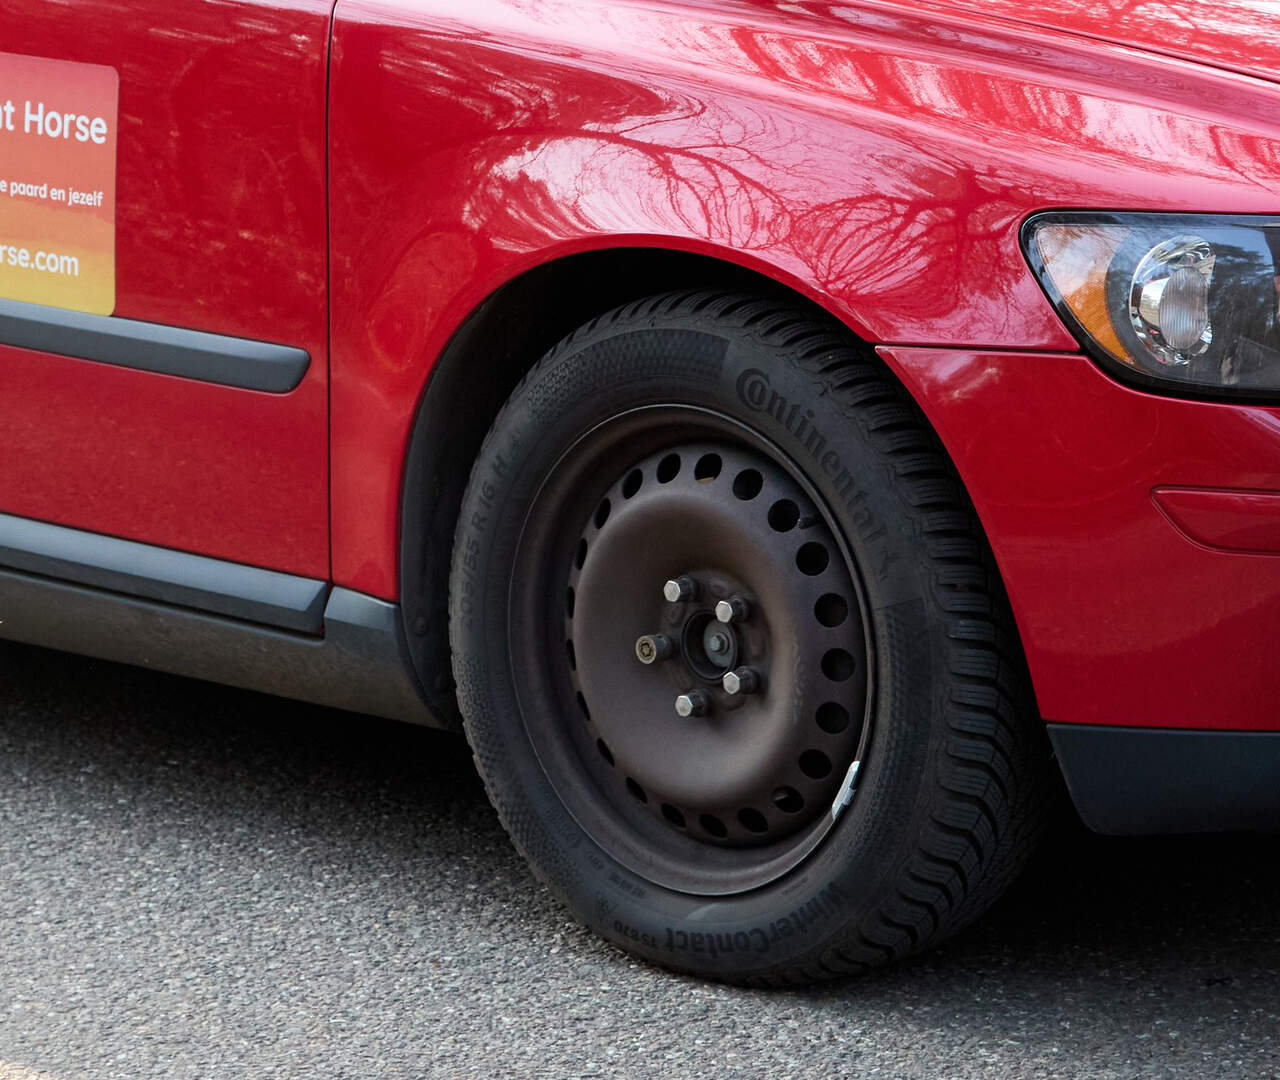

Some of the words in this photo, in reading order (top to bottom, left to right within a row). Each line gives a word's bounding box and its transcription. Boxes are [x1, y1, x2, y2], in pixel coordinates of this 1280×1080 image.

[23, 100, 108, 144] Horse
[10, 180, 47, 200] paard
[50, 187, 66, 202] en
[68, 188, 104, 208] jezelf
[735, 367, 889, 544] Continental
